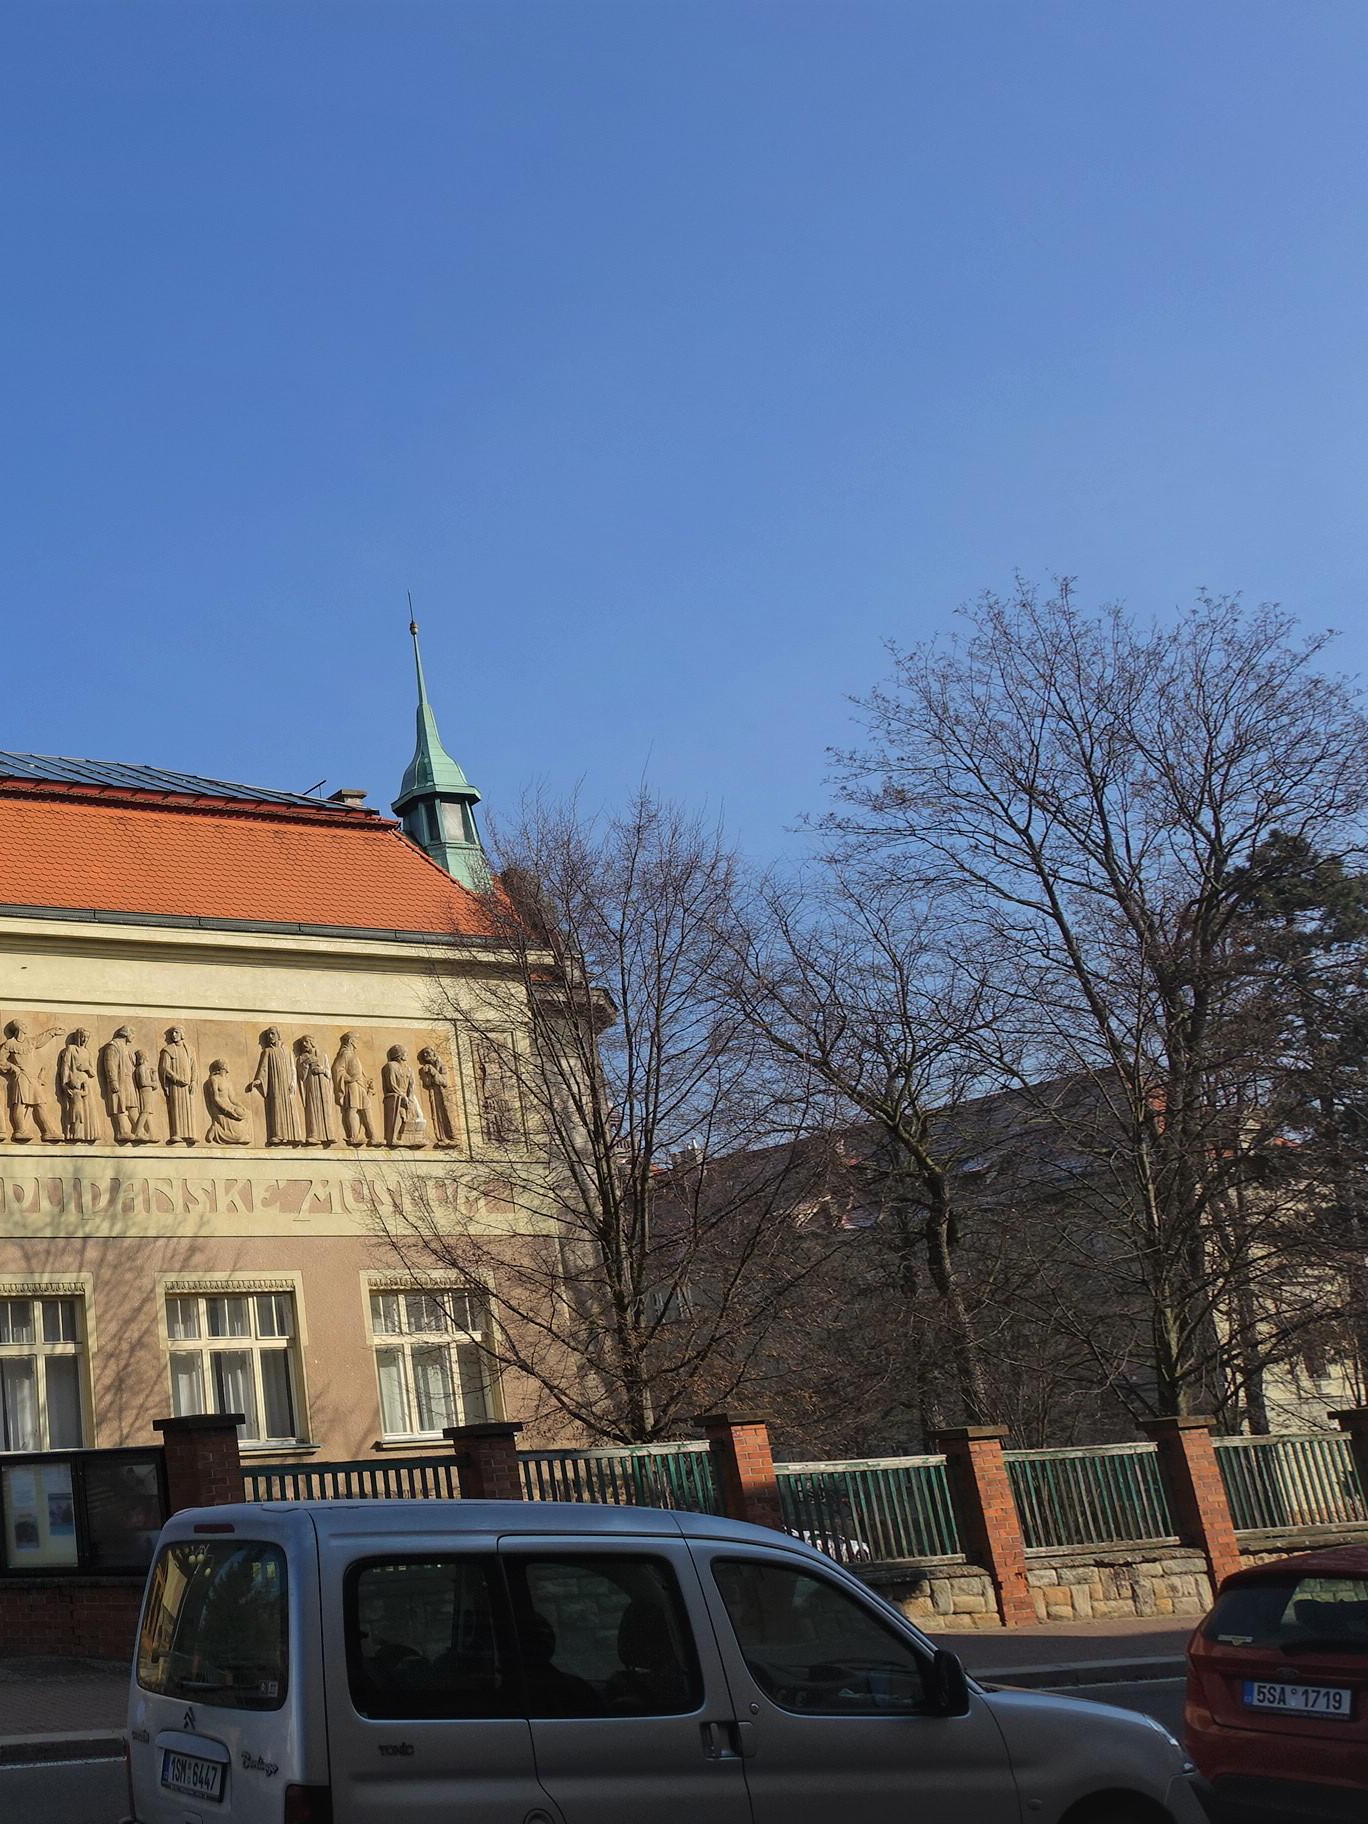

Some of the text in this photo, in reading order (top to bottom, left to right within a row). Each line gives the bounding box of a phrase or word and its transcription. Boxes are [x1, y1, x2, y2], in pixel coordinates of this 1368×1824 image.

[1256, 1684, 1342, 1710] 5SA 1719
[192, 1762, 218, 1792] 6447
